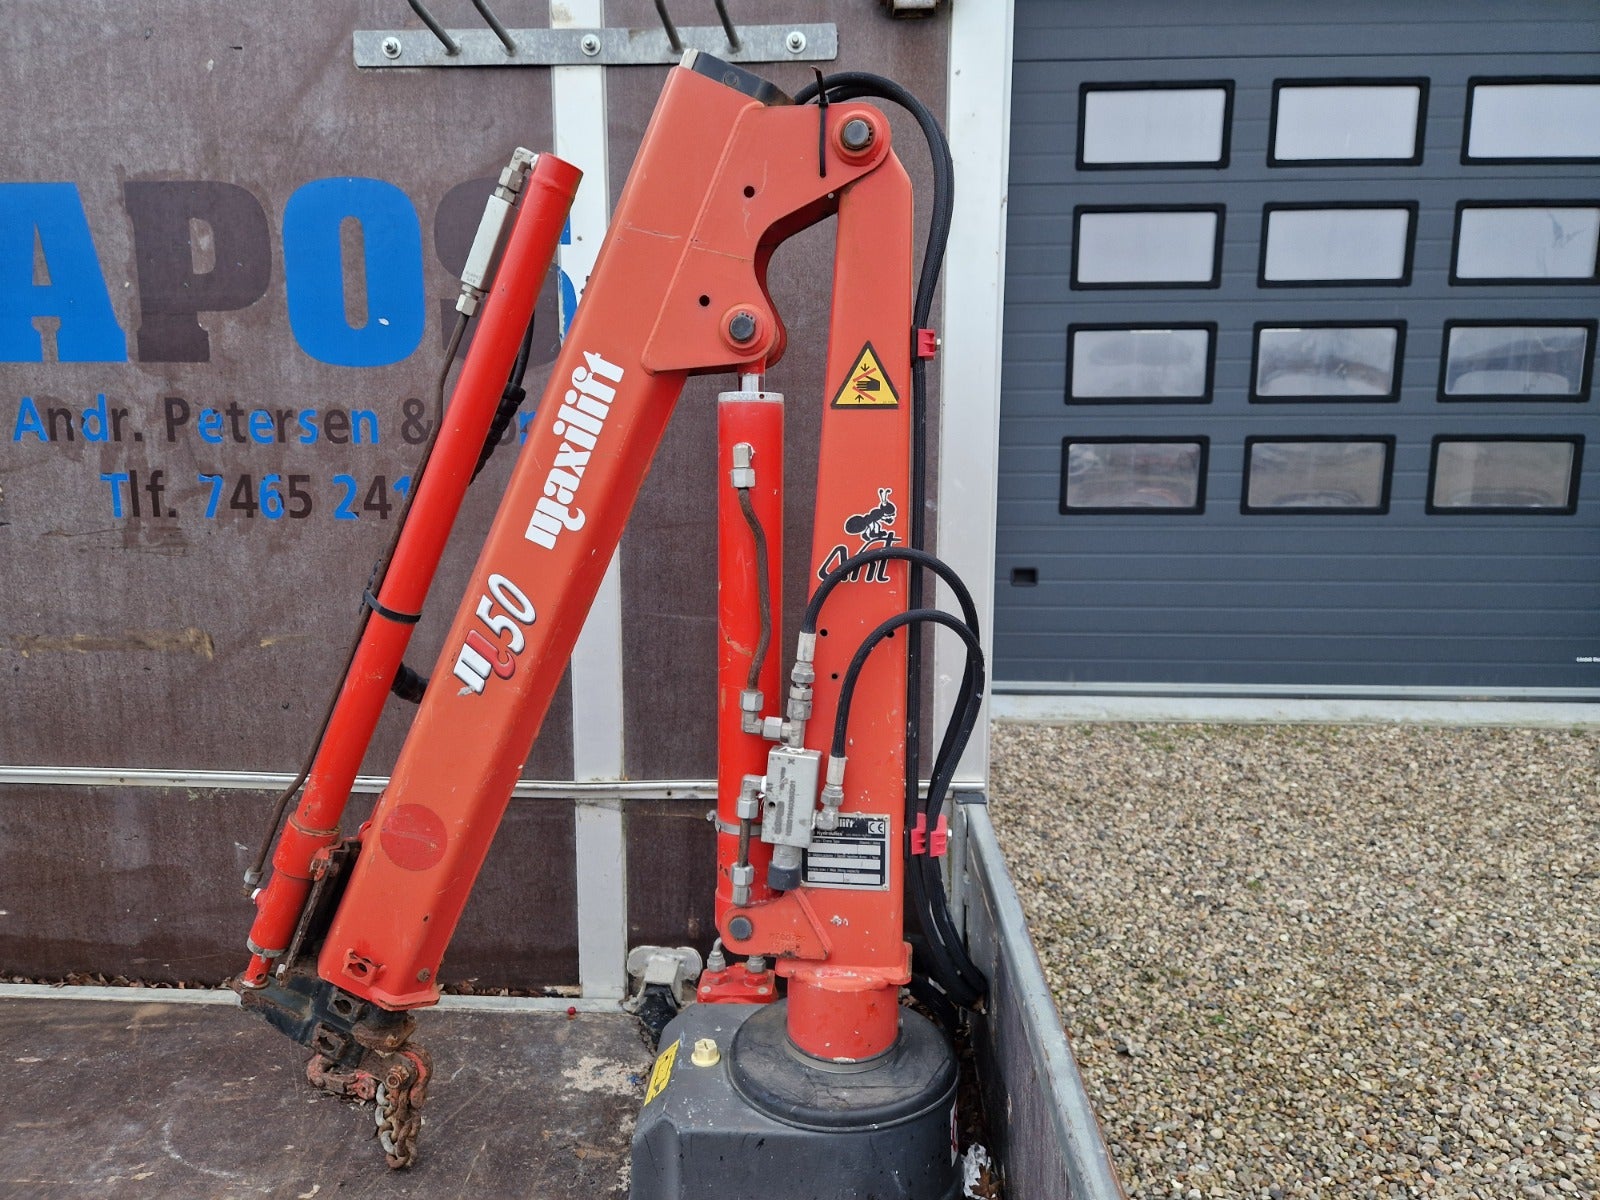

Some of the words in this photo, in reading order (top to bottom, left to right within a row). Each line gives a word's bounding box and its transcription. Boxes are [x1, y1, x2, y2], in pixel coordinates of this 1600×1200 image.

[13, 393, 143, 442] Andr.
[164, 397, 379, 444] Petersen
[401, 398, 434, 444] &
[524, 350, 625, 550] maxilift
[100, 469, 177, 518] Tlf.
[198, 473, 312, 519] 7465
